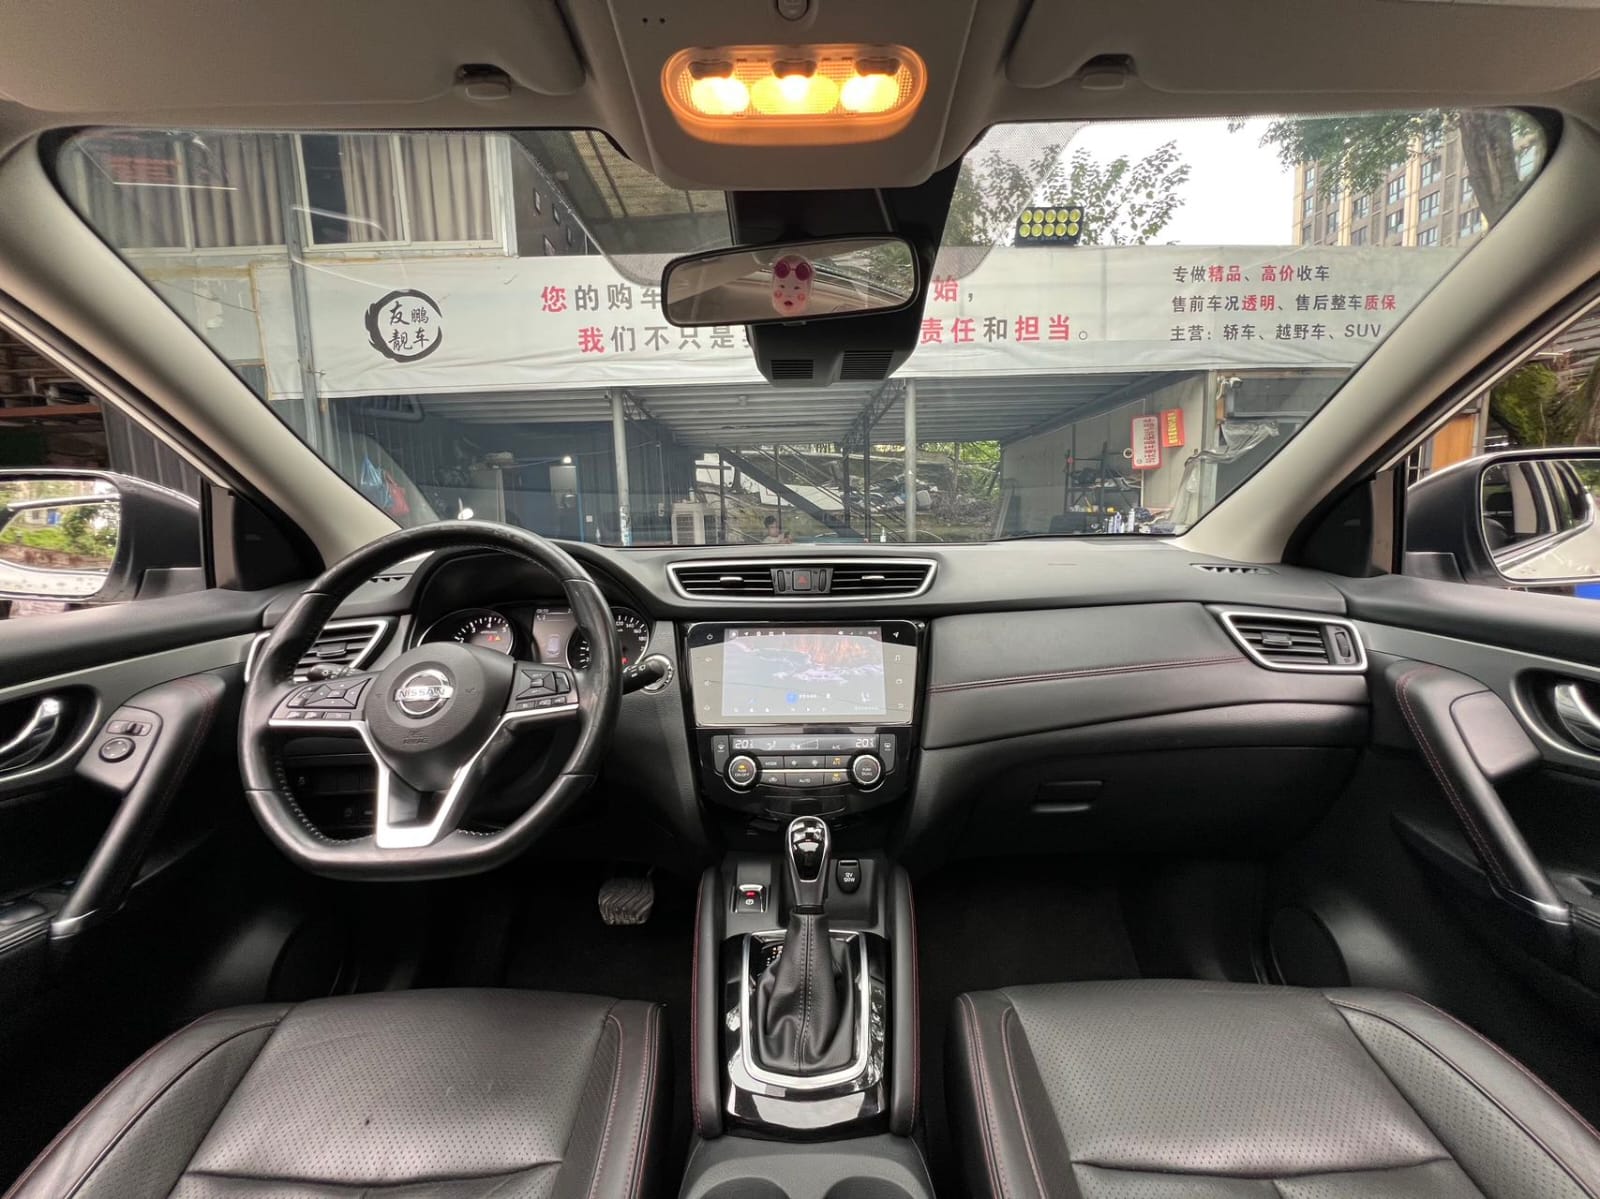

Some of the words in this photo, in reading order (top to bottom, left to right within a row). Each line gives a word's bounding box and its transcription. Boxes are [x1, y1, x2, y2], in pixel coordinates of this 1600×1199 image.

[1173, 265, 1330, 282] 专做精品、高价收车
[389, 301, 429, 325] 友鹏
[1172, 295, 1397, 312] 售前车况透明、售后整车质保
[388, 327, 429, 351] 靓车
[578, 326, 750, 353] 我们不只是
[399, 687, 446, 698] NISSAN
